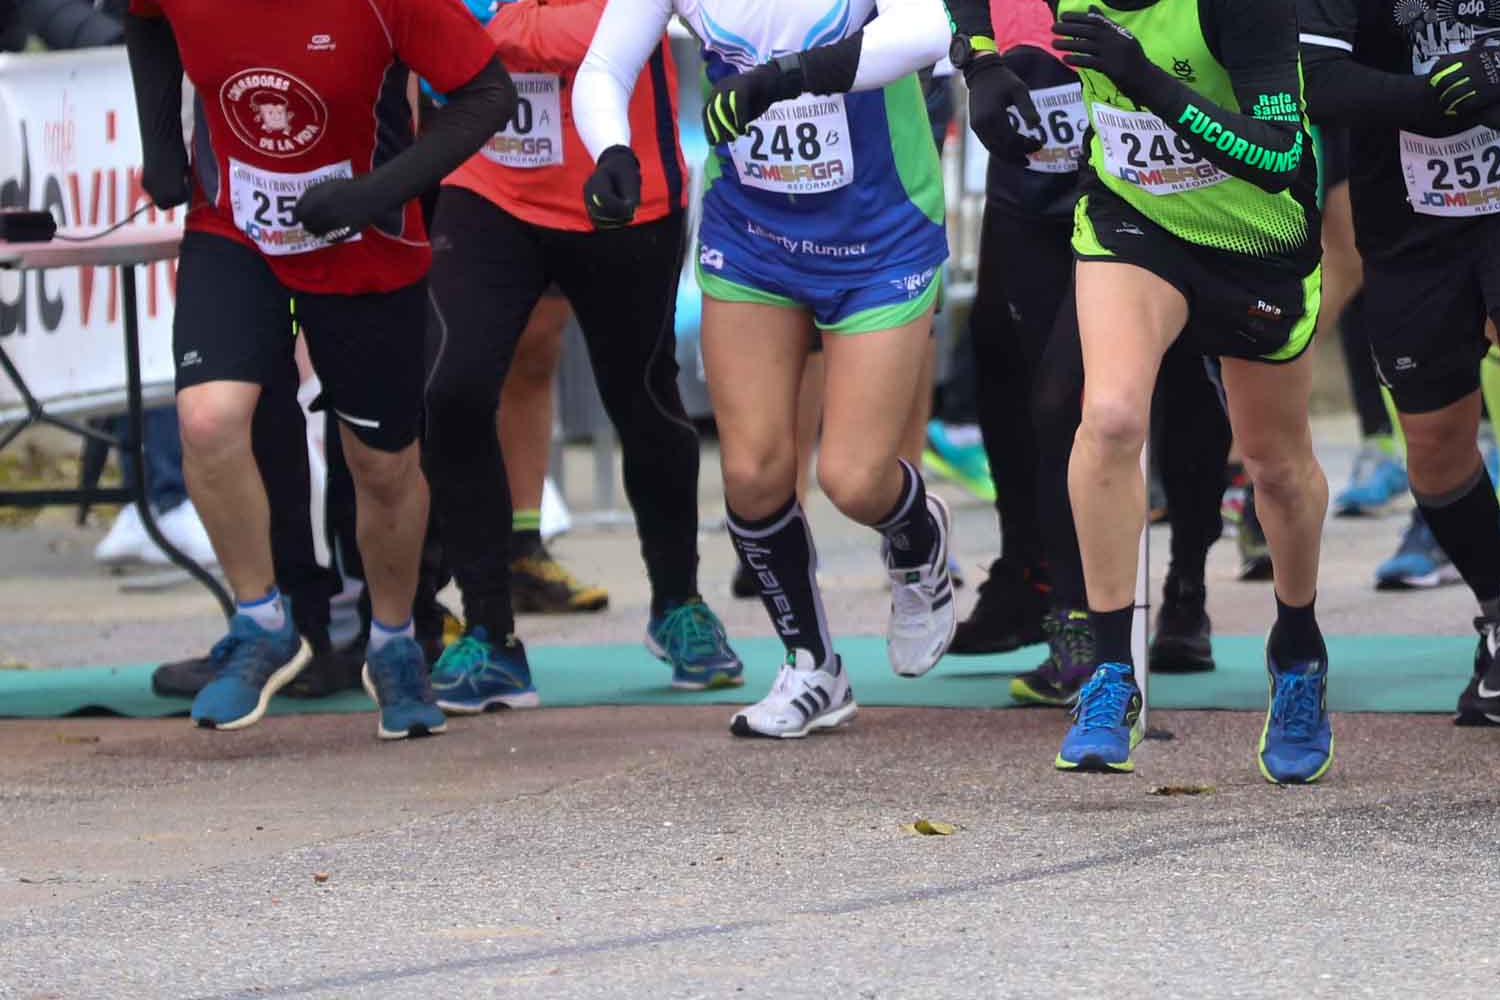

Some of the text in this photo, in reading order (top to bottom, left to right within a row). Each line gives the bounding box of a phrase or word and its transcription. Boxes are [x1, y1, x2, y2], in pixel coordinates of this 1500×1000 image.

[227, 74, 290, 102] CORREDORES
[1259, 92, 1291, 105] Rafa
[538, 109, 551, 127] A
[1253, 102, 1297, 116] Santos
[259, 137, 295, 151] DE LA
[294, 124, 320, 145] VIDA
[747, 122, 821, 161] 248
[1120, 132, 1201, 167] 249
[743, 159, 844, 182] JOMISAGA
[1172, 172, 1228, 191] REFORMA
[253, 190, 298, 226] 25
[747, 220, 866, 256] Liberty Runner
